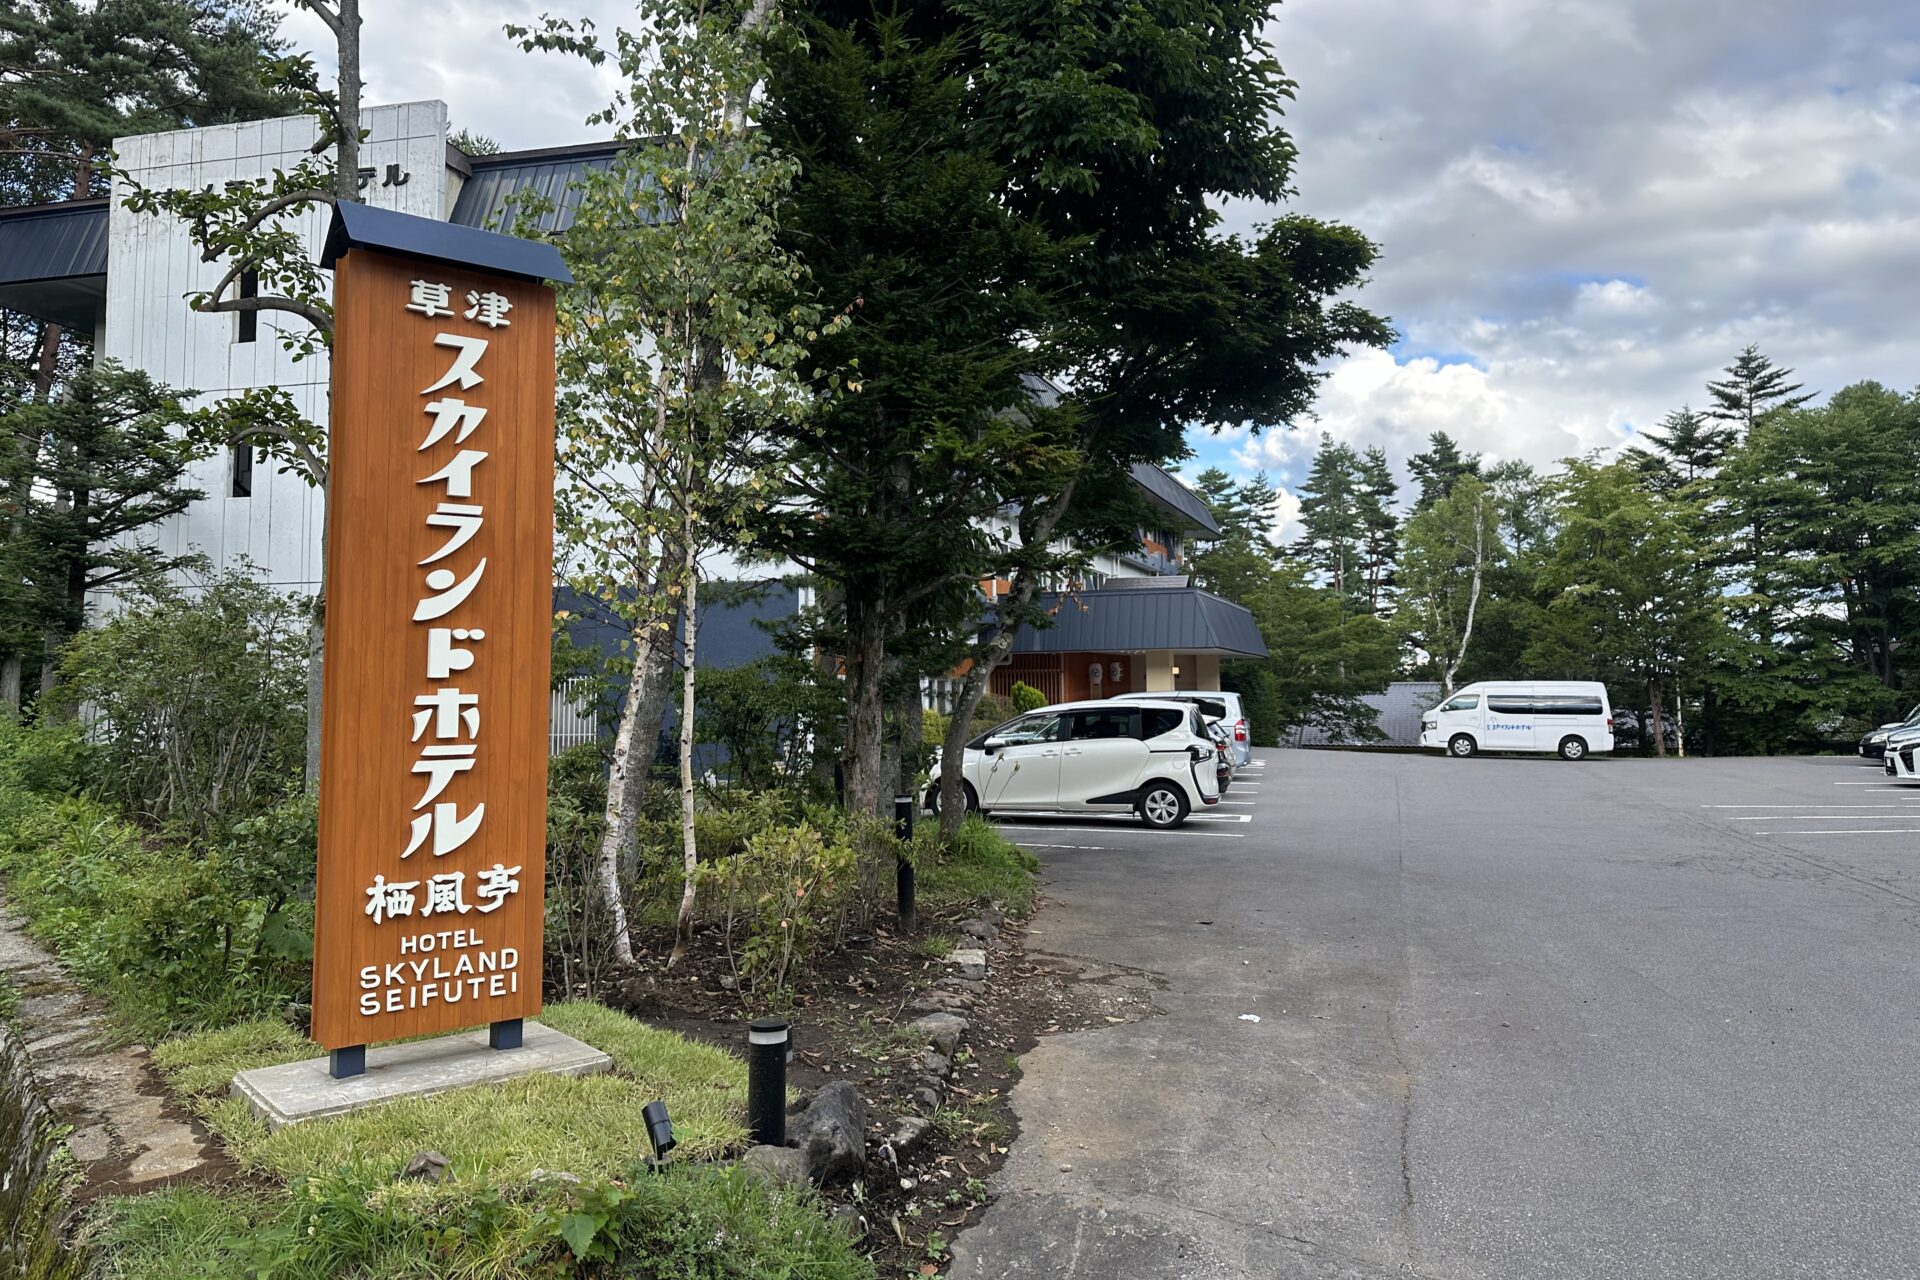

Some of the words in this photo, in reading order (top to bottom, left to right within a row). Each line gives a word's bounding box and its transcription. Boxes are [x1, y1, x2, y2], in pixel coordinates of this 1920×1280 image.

[405, 279, 514, 328] 草津
[401, 332, 489, 859] スカイランドホテル
[365, 863, 522, 925] 栖風亭
[401, 928, 484, 955] HOTEL
[360, 947, 519, 989] SKYLAND
[360, 971, 517, 1016] SEIFUTEI
